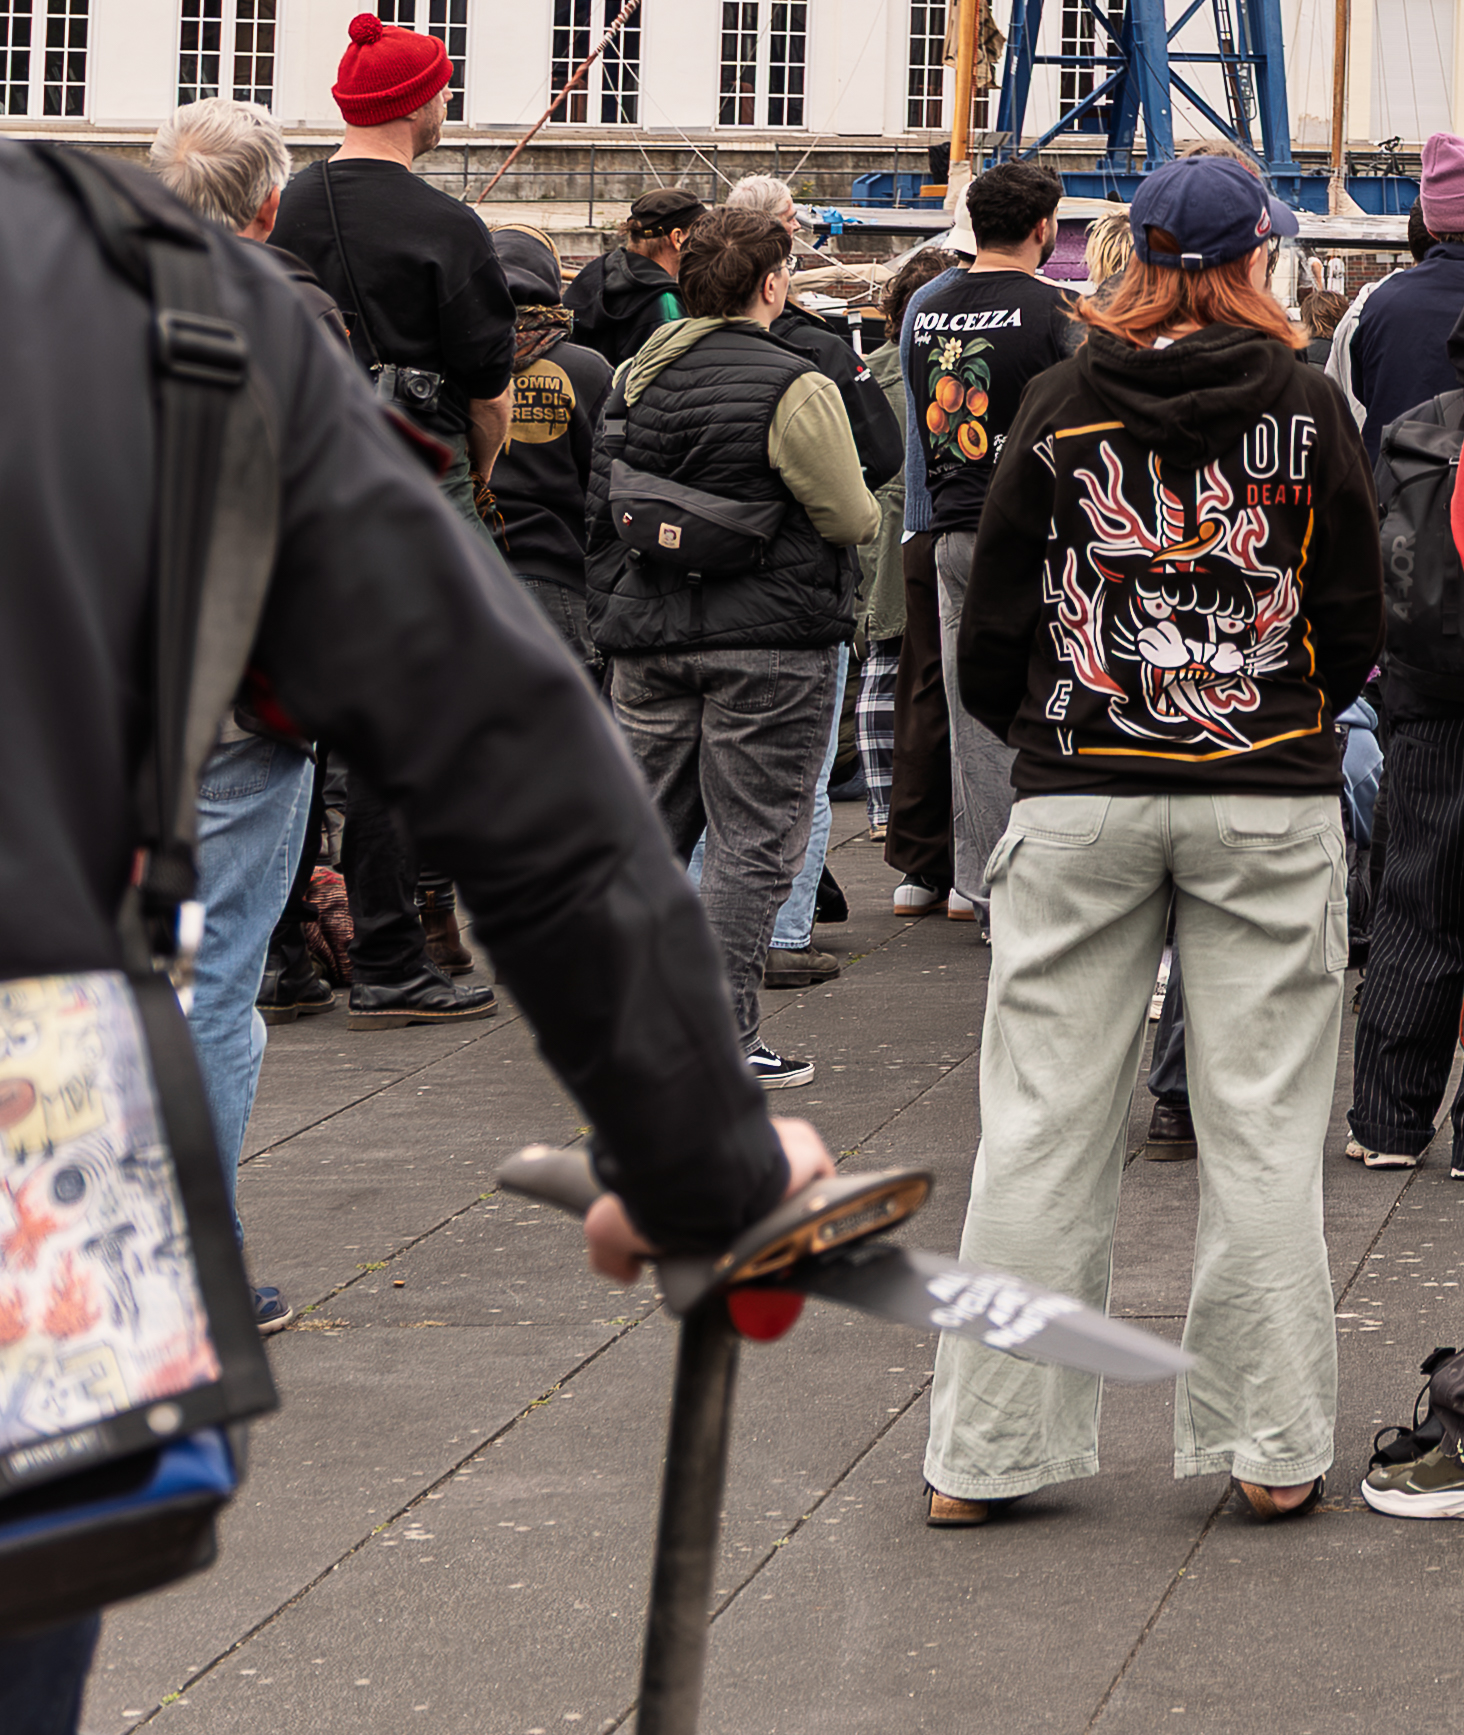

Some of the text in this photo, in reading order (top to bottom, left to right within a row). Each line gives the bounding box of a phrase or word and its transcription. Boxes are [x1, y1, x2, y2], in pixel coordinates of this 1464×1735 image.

[913, 307, 1022, 332] DOLCEZZA
[513, 375, 561, 391] OMM
[513, 406, 567, 421] RESSE
[1243, 413, 1318, 480] OF
